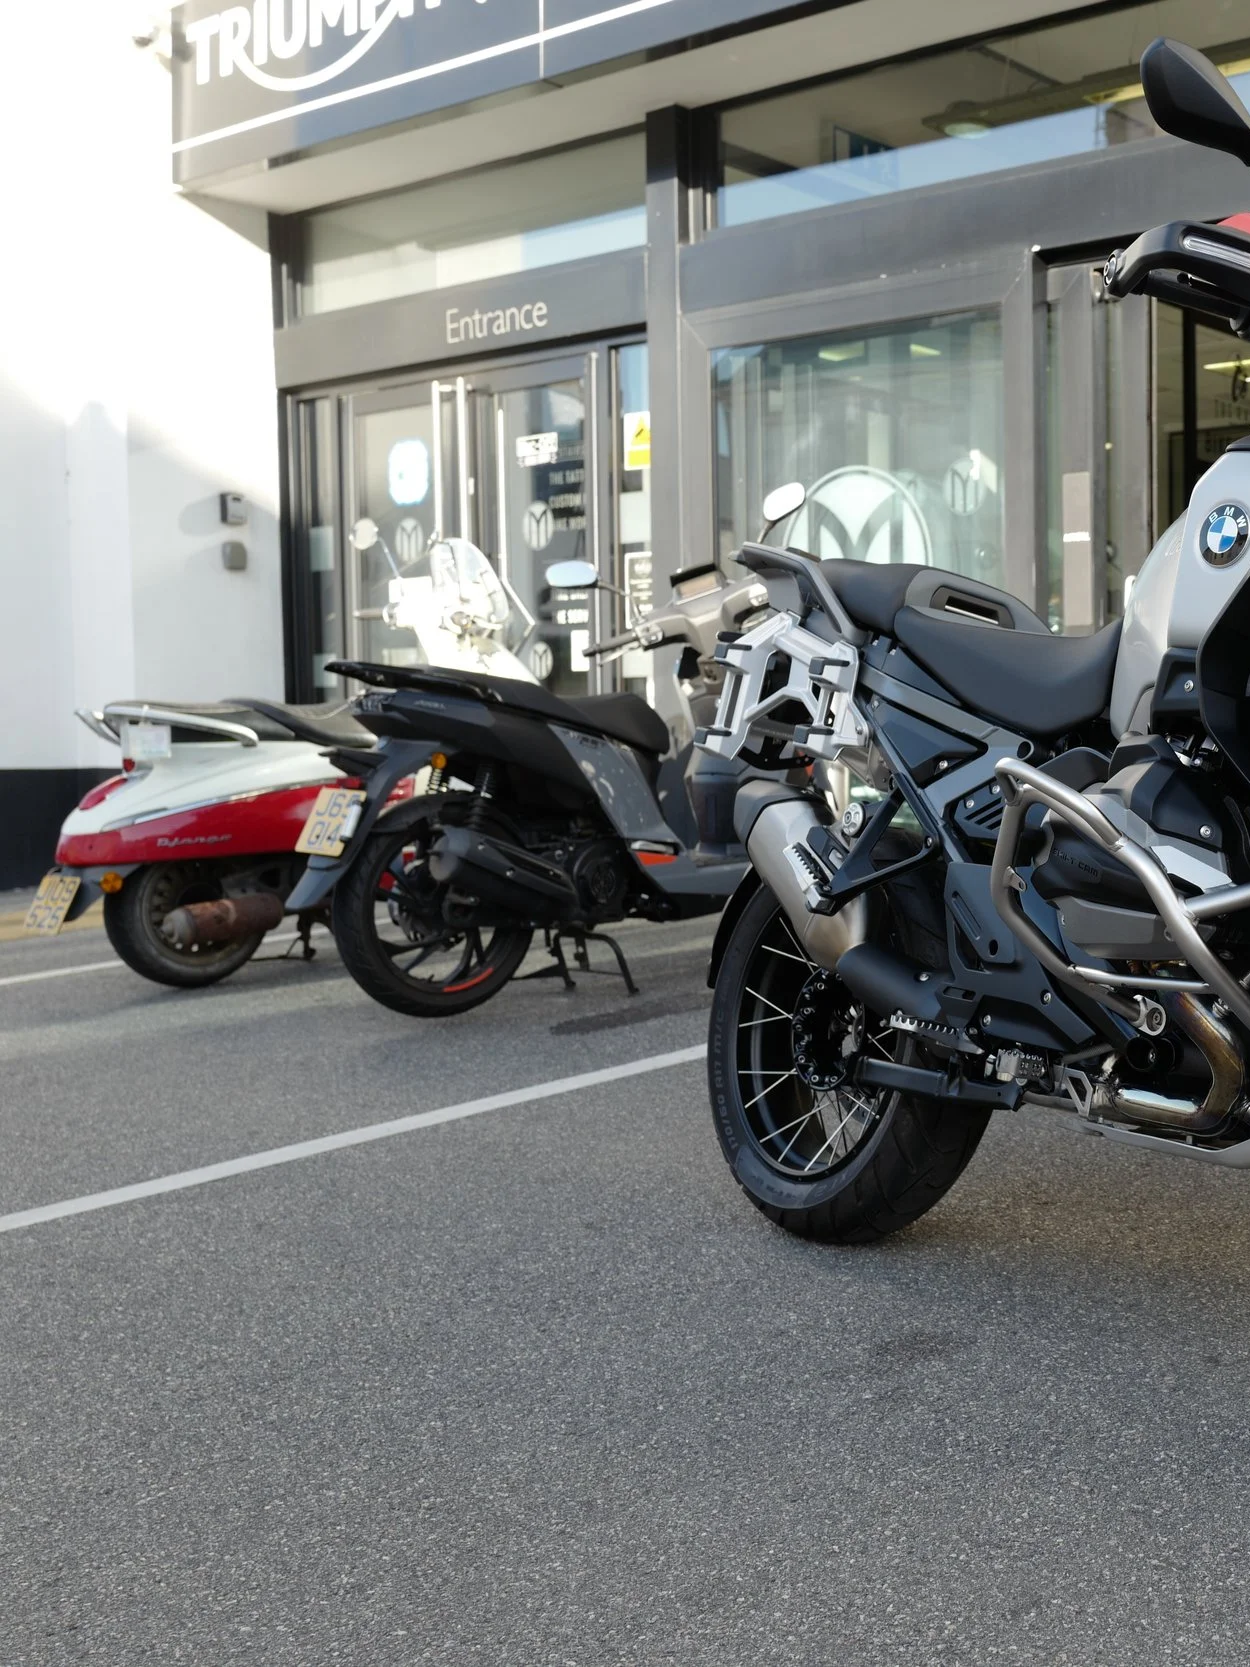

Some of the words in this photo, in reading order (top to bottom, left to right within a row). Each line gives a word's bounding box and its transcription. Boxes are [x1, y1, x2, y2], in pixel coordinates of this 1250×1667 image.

[184, 0, 441, 91] TRIUM
[446, 301, 548, 344] Entrance
[1208, 506, 1248, 529] BMW
